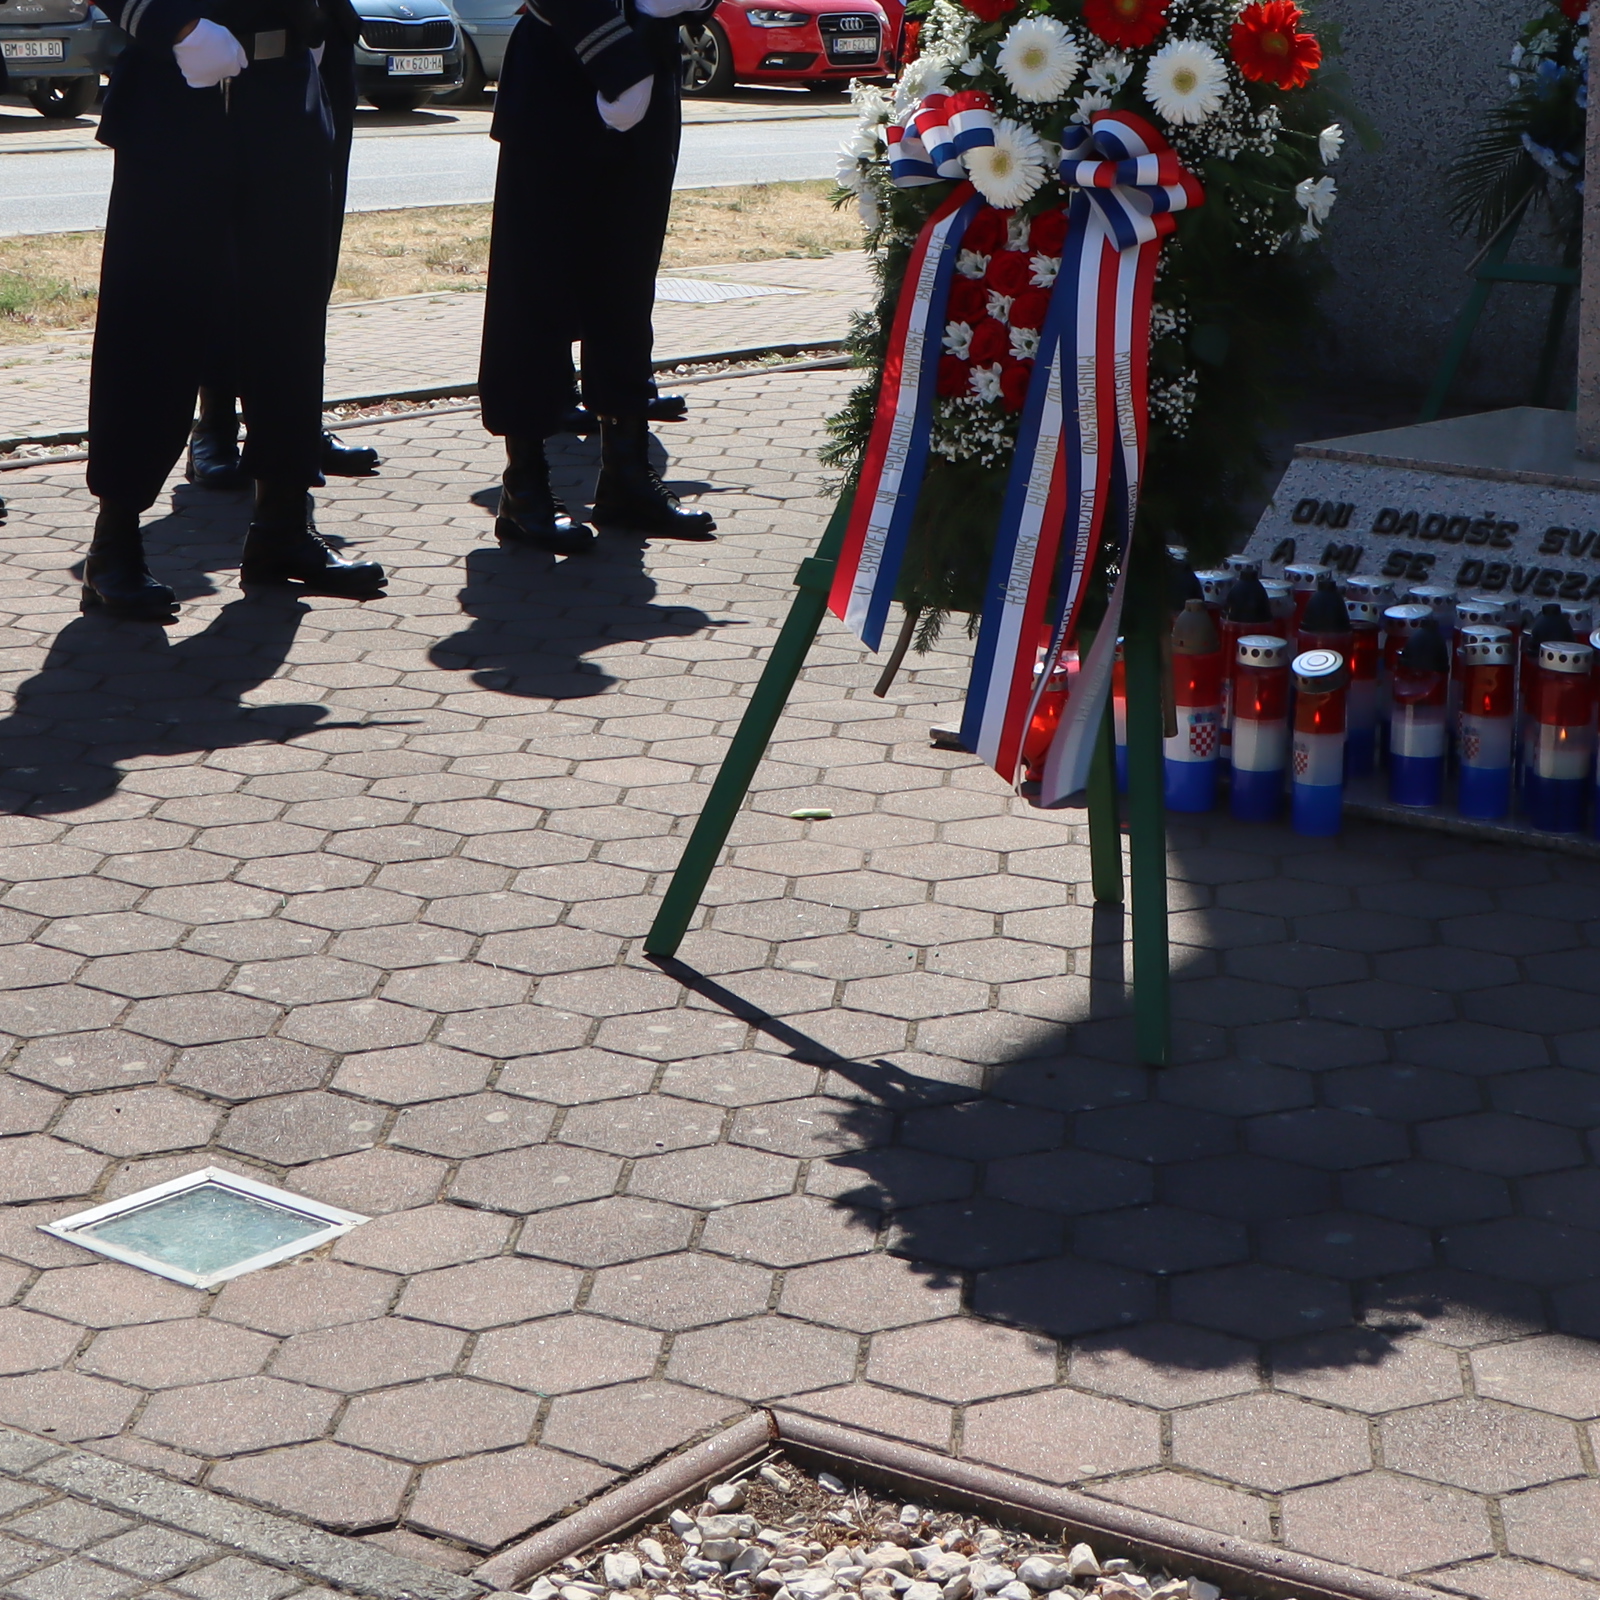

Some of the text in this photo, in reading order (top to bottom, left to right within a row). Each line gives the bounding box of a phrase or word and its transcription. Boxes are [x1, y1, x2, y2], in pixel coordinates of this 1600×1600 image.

[1072, 355, 1098, 456] MINISTARSTVO
[1114, 351, 1138, 448] MINISTARSTVO
[858, 524, 889, 574] SPOMEN
[900, 327, 928, 389] HRVATSKE
[997, 434, 1060, 606] HRVATSKIH BRANITELJA
[1271, 536, 1297, 565] A
[1319, 542, 1365, 574] MI
[1381, 549, 1437, 582] SE
[1291, 497, 1355, 530] ONI
[1372, 507, 1520, 549] DADOŠE
